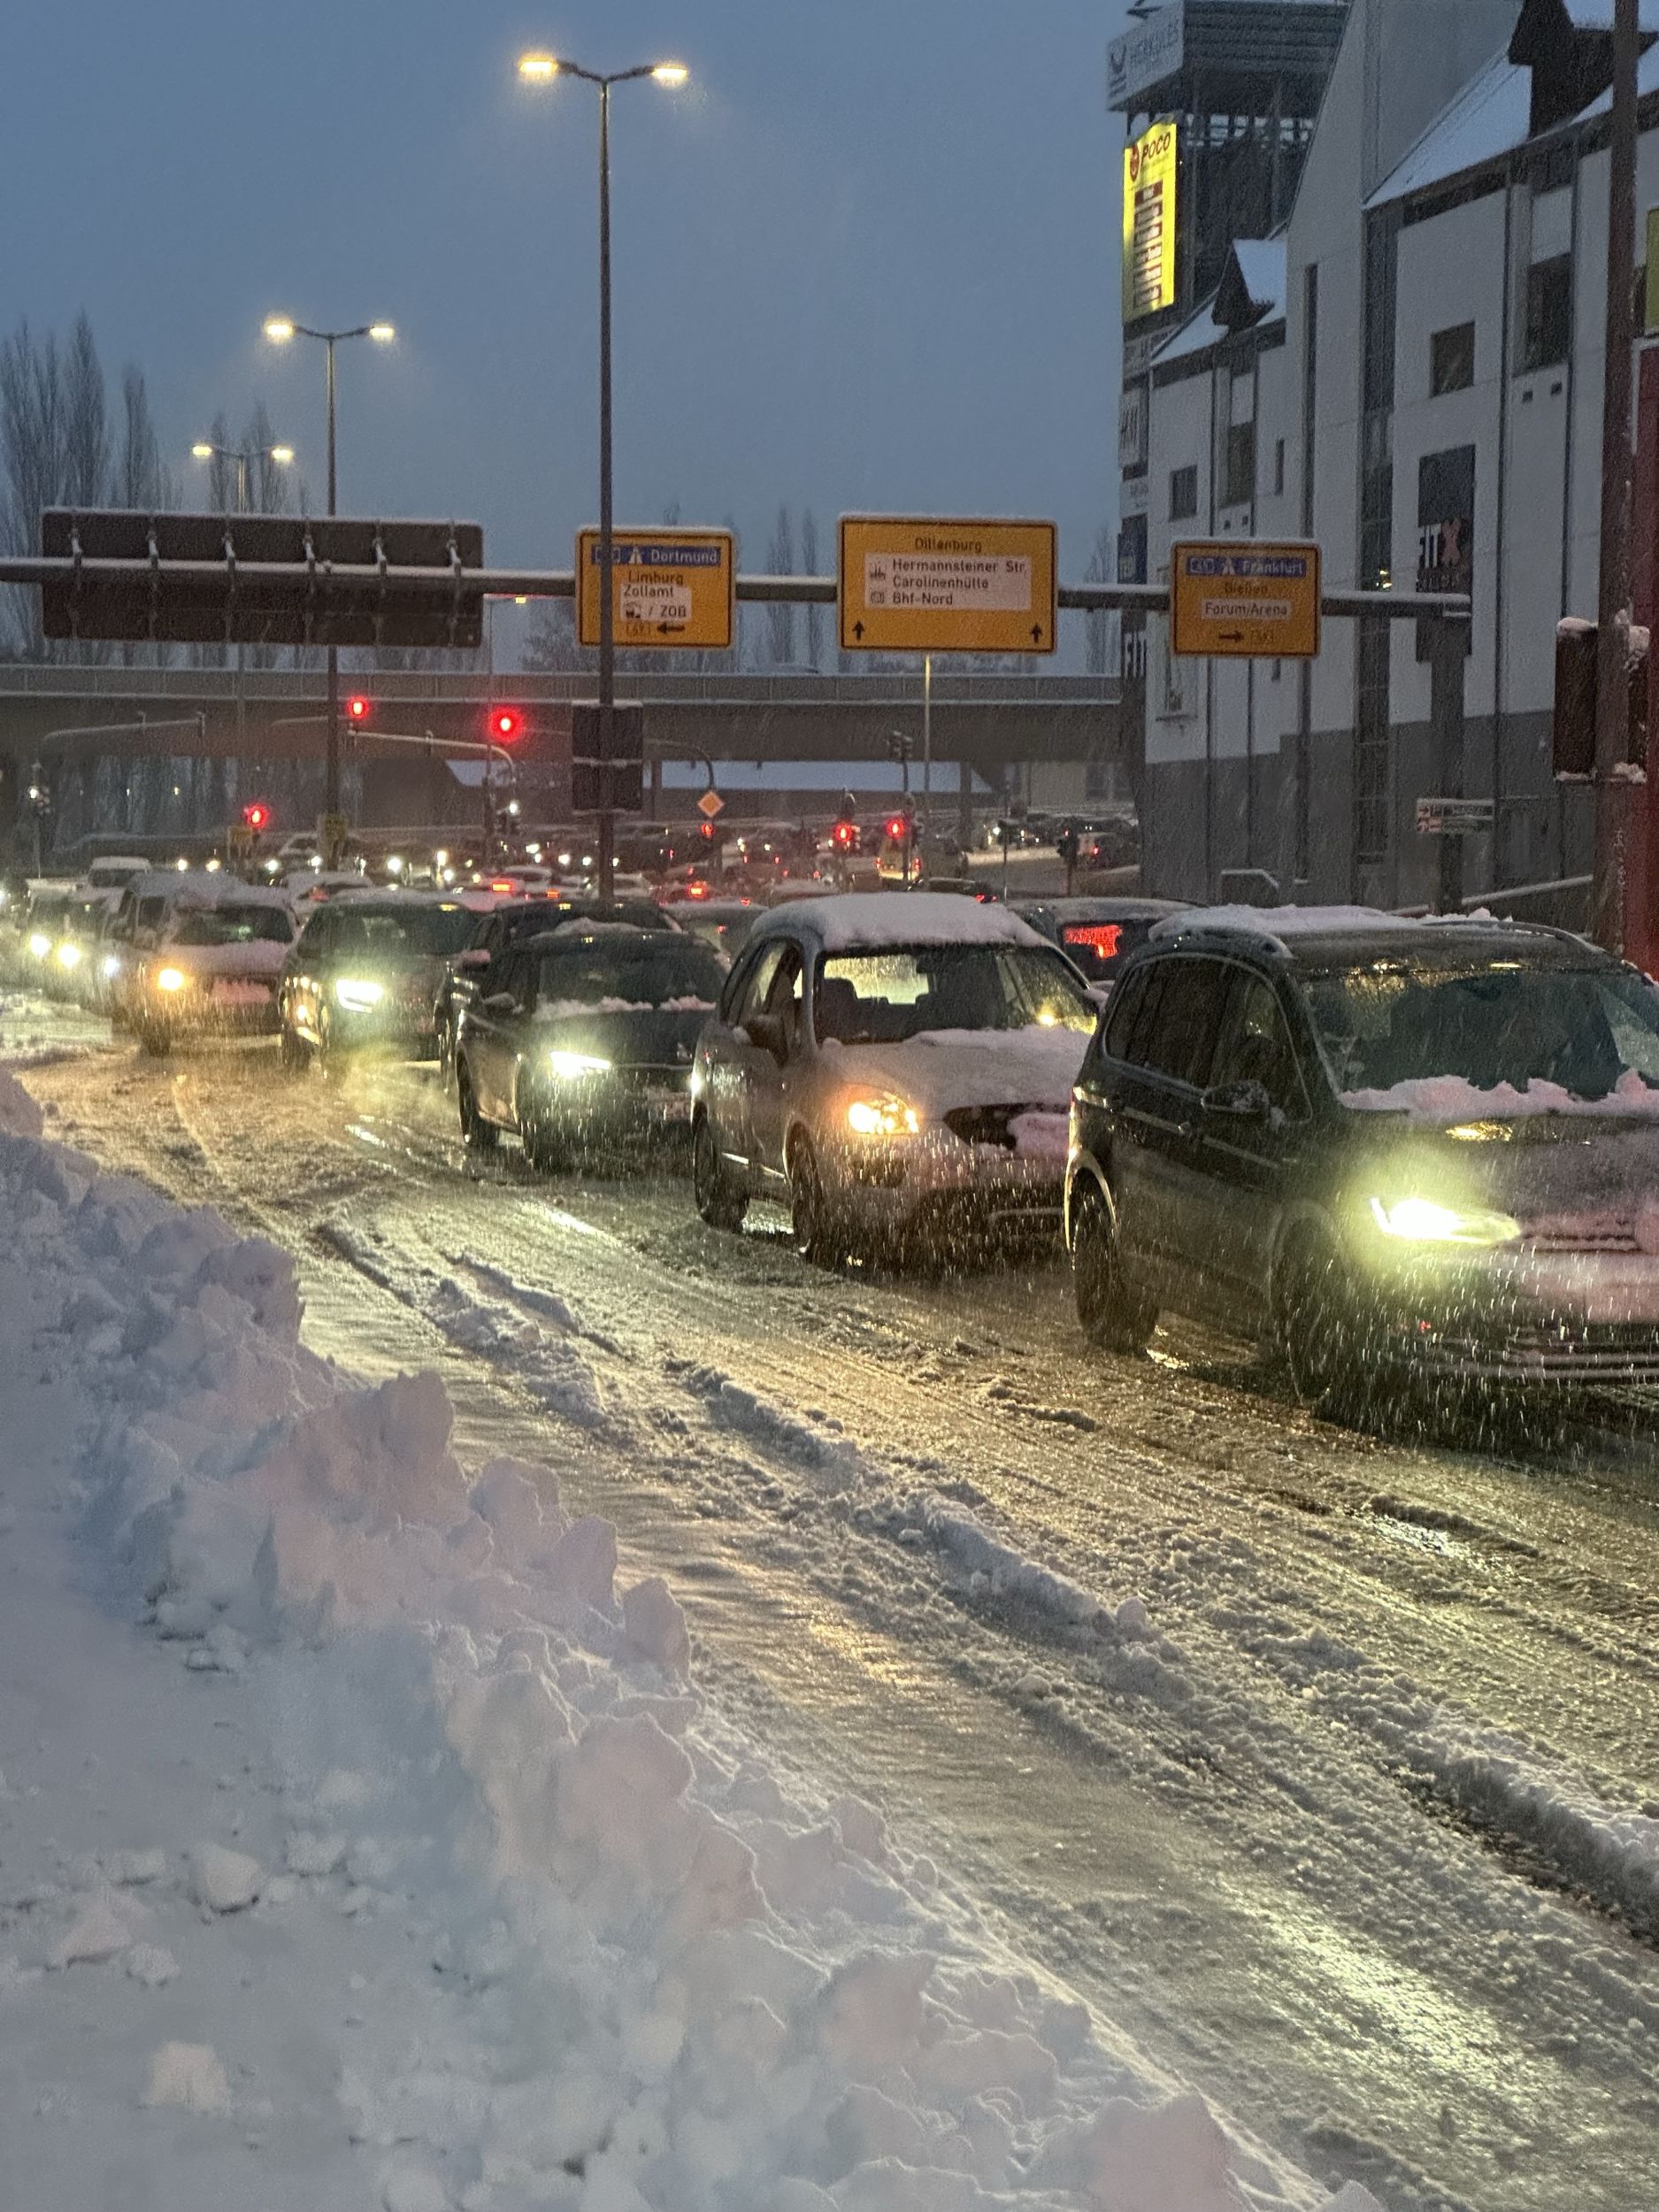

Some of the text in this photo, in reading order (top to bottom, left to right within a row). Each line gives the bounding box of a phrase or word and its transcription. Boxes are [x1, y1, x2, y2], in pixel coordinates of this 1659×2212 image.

[1141, 131, 1171, 167] POCO
[915, 537, 982, 553] Dillenburg
[650, 548, 718, 563] Dortmund
[893, 558, 998, 572] Hermannsteiner
[1243, 559, 1303, 574] Frankfurt
[629, 571, 684, 586] Limburg
[893, 575, 989, 589] Carolinenhütte
[624, 585, 674, 597] Zollamt
[893, 592, 953, 605] Bhf-Nord
[660, 605, 687, 618] ZOB
[1205, 602, 1287, 617] Forum/Arena
